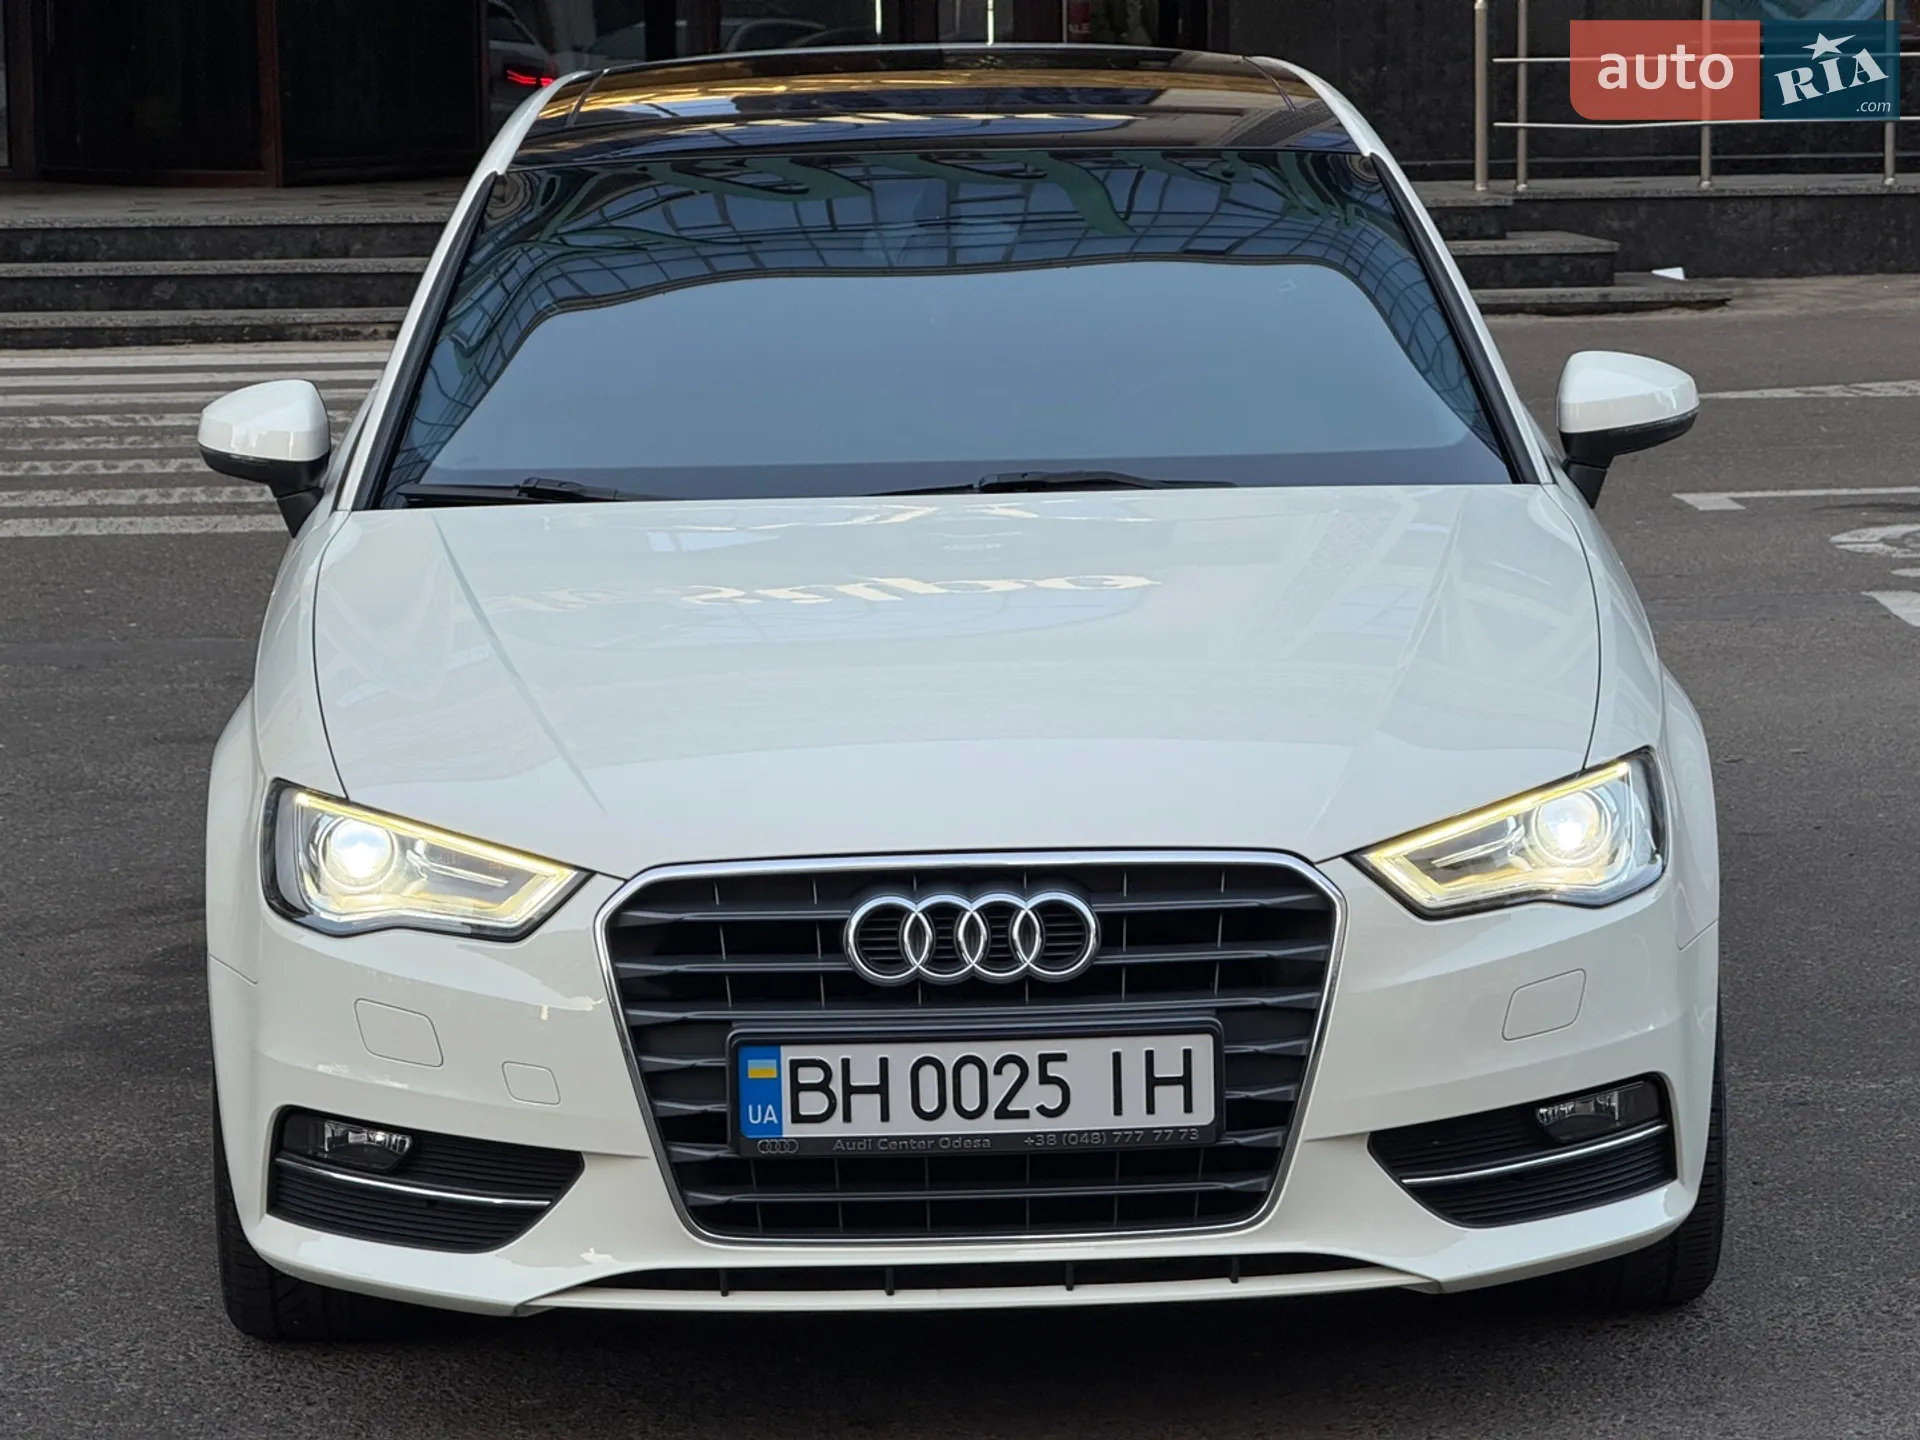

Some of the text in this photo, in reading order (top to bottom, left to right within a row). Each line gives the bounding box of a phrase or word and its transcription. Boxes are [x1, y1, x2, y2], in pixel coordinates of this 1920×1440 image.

[789, 1048, 1193, 1124] BH 0025 IH
[748, 1103, 779, 1124] UA
[832, 1135, 992, 1152] Audi Center Odesa
[1024, 1128, 1200, 1147] +38 (048) 777 77 73
